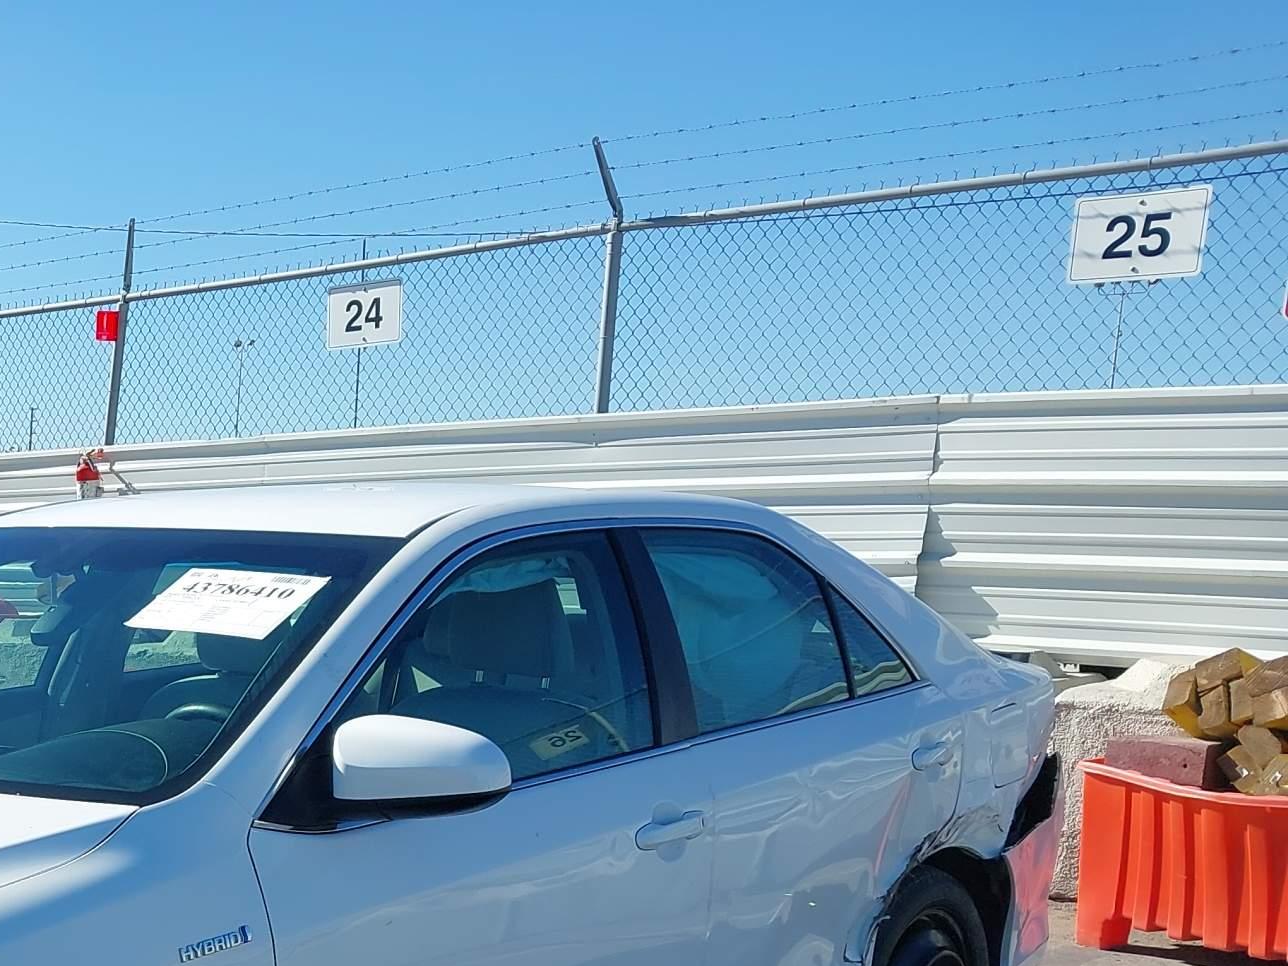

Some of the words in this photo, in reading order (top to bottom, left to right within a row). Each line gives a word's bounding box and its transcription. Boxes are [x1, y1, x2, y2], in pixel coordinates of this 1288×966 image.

[1101, 211, 1173, 260] 25
[344, 296, 384, 333] 24
[182, 580, 297, 600] 43786410
[178, 930, 242, 963] HYBRID
